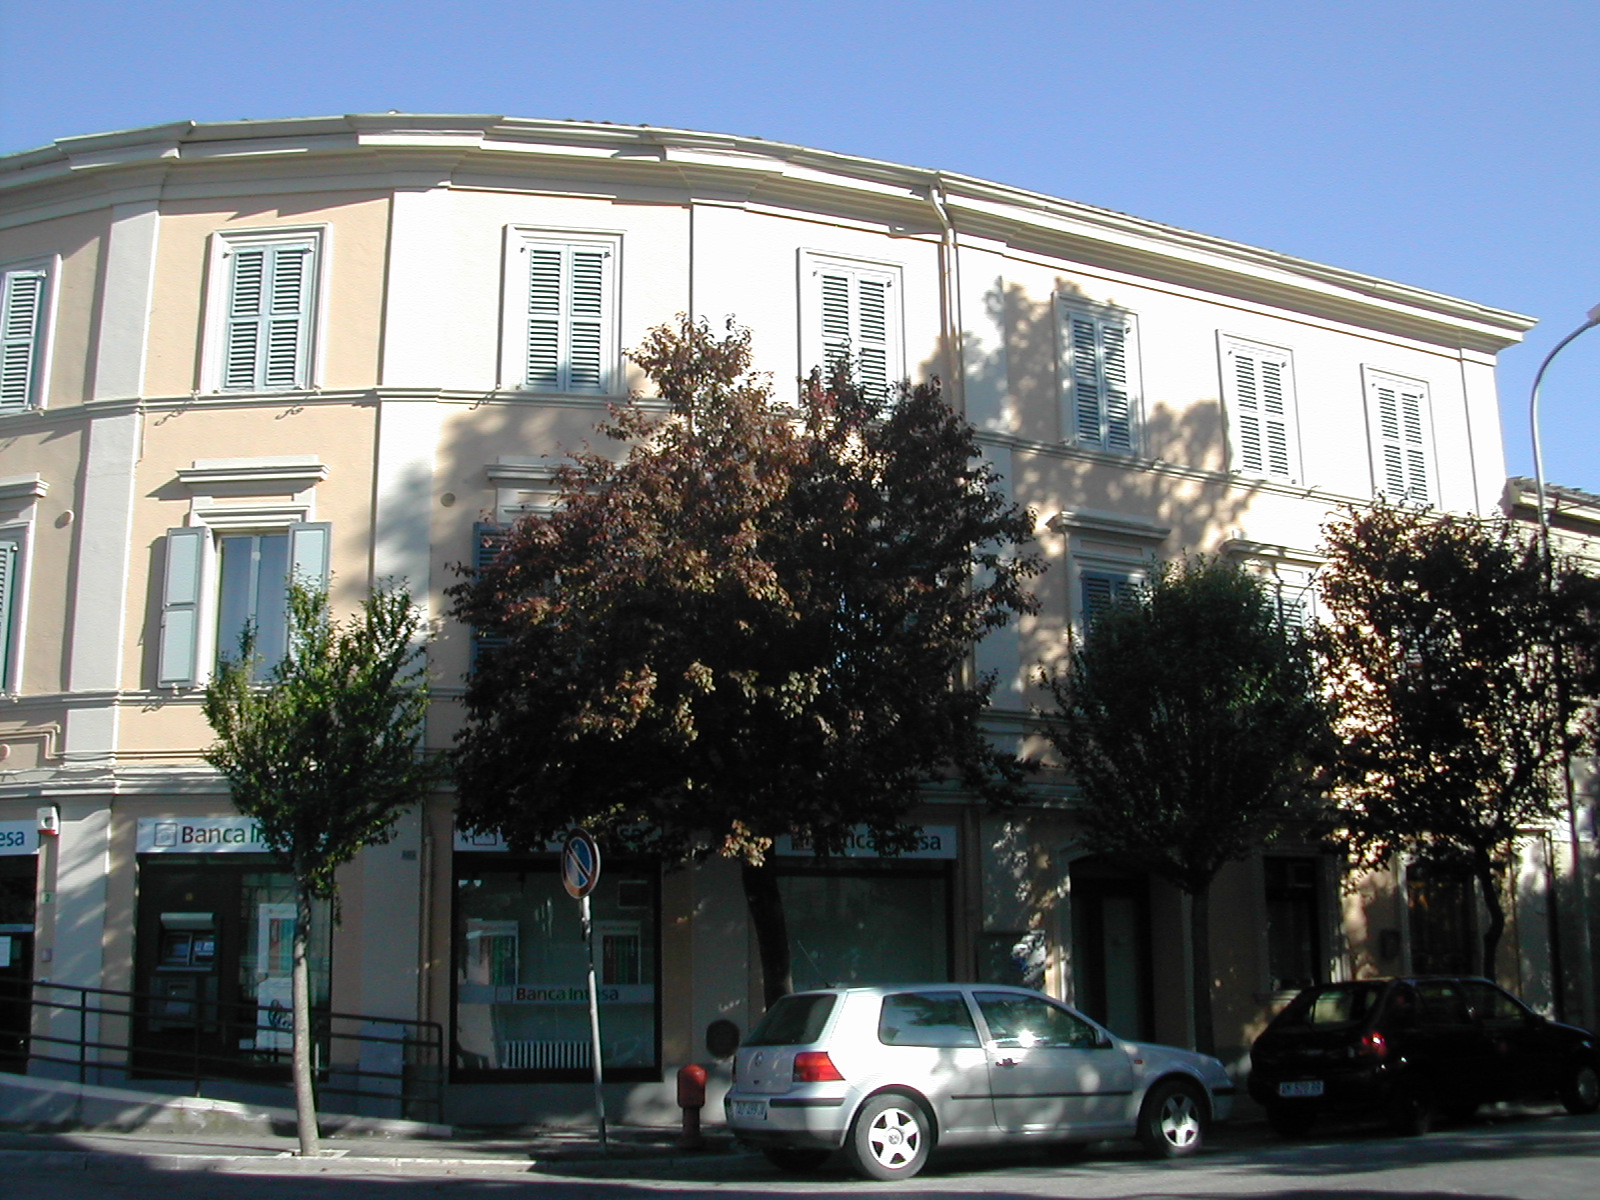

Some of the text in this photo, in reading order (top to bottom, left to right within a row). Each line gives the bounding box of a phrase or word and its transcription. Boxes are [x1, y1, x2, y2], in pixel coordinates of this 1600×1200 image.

[182, 826, 245, 844] Banca
[516, 987, 619, 1001] Banca Intsa
